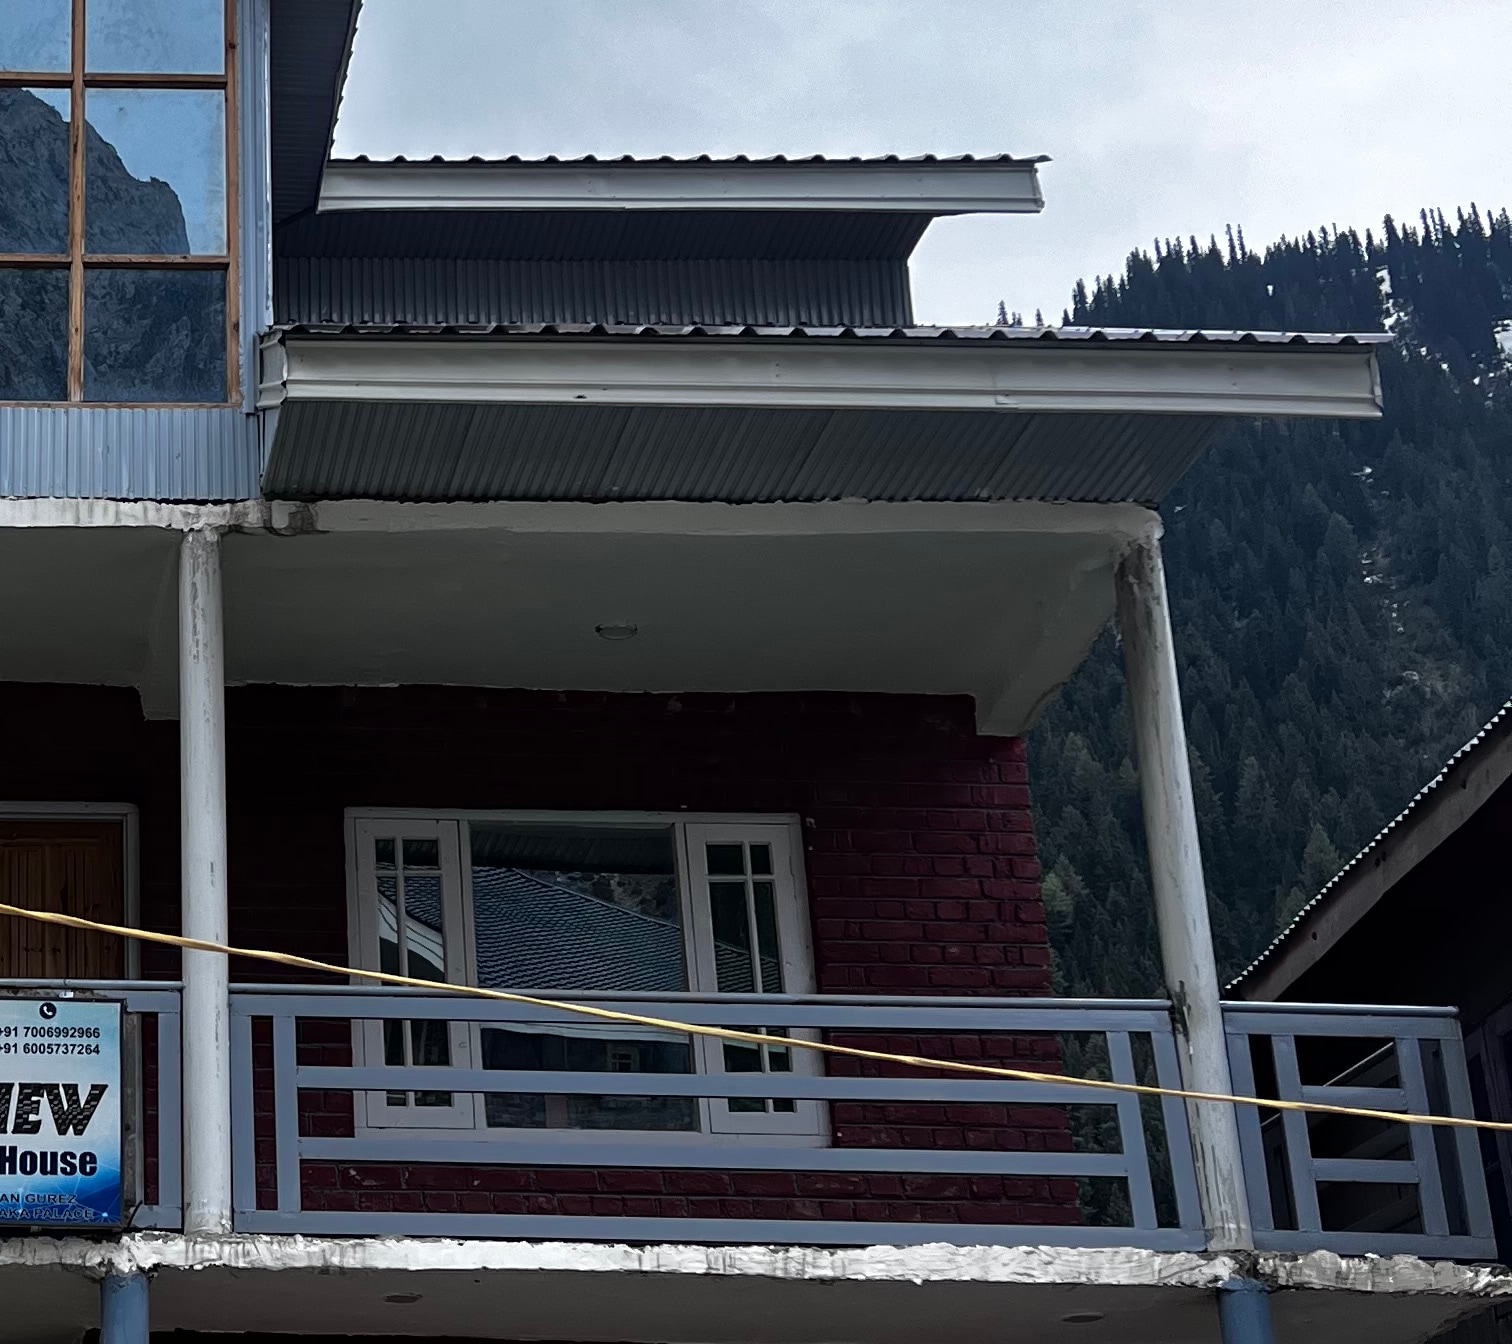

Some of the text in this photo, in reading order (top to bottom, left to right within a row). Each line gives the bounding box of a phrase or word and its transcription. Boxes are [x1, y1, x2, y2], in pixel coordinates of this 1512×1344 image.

[23, 1026, 100, 1039] 7006992966
[23, 1043, 100, 1056] 6005737264
[24, 1193, 77, 1204] GUREZ
[34, 1208, 94, 1220] PALACE
